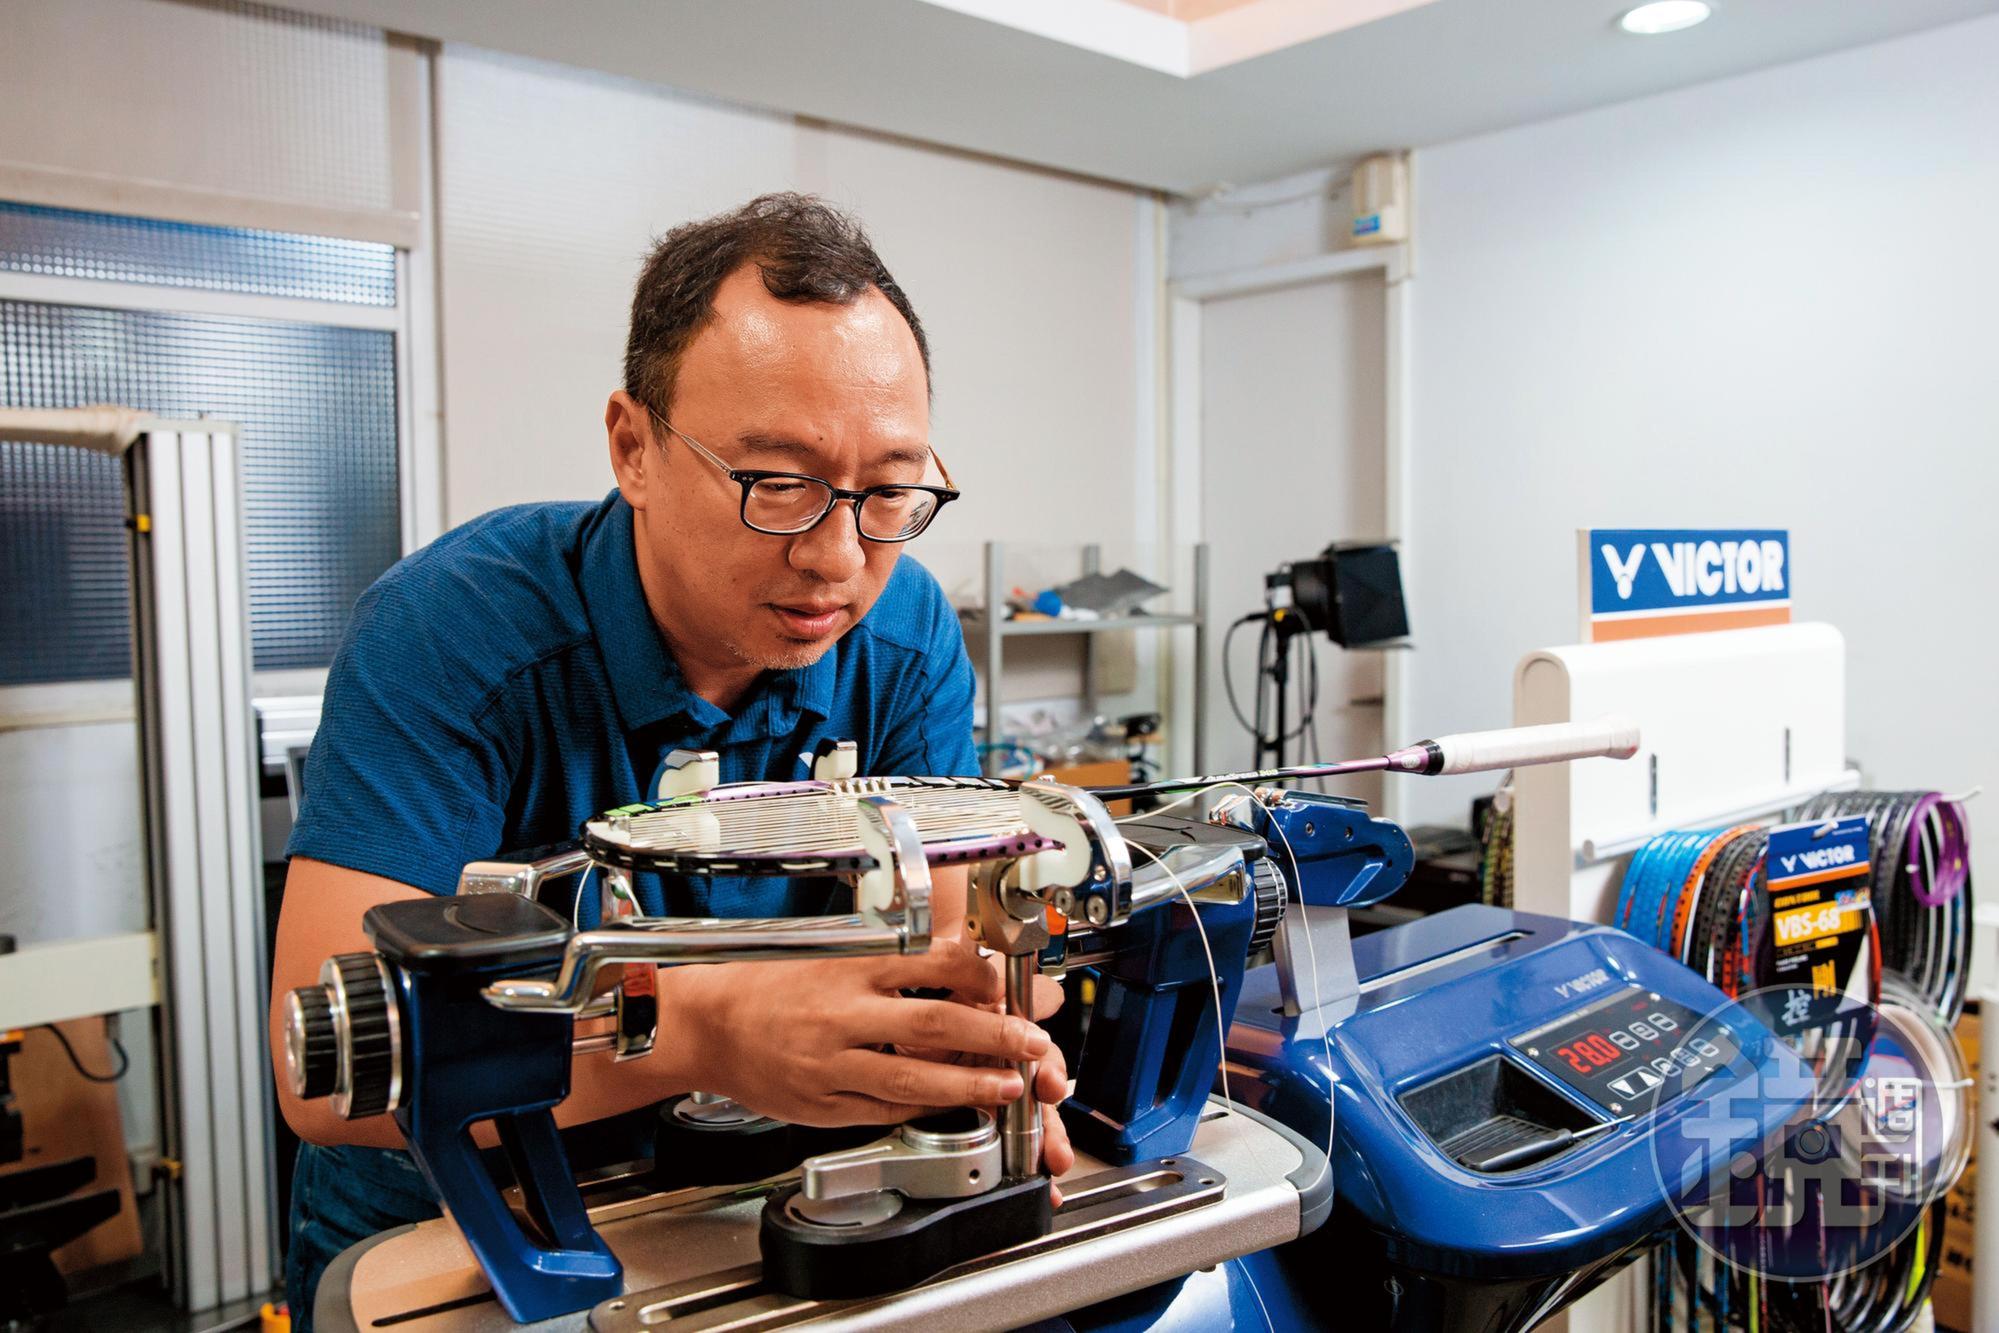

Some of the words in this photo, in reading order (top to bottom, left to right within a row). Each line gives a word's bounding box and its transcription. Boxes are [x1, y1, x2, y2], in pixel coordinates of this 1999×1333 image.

[1650, 539, 1785, 597] VICTOR
[1798, 844, 1855, 869] VICTOR
[1776, 907, 1841, 940] VBS-68
